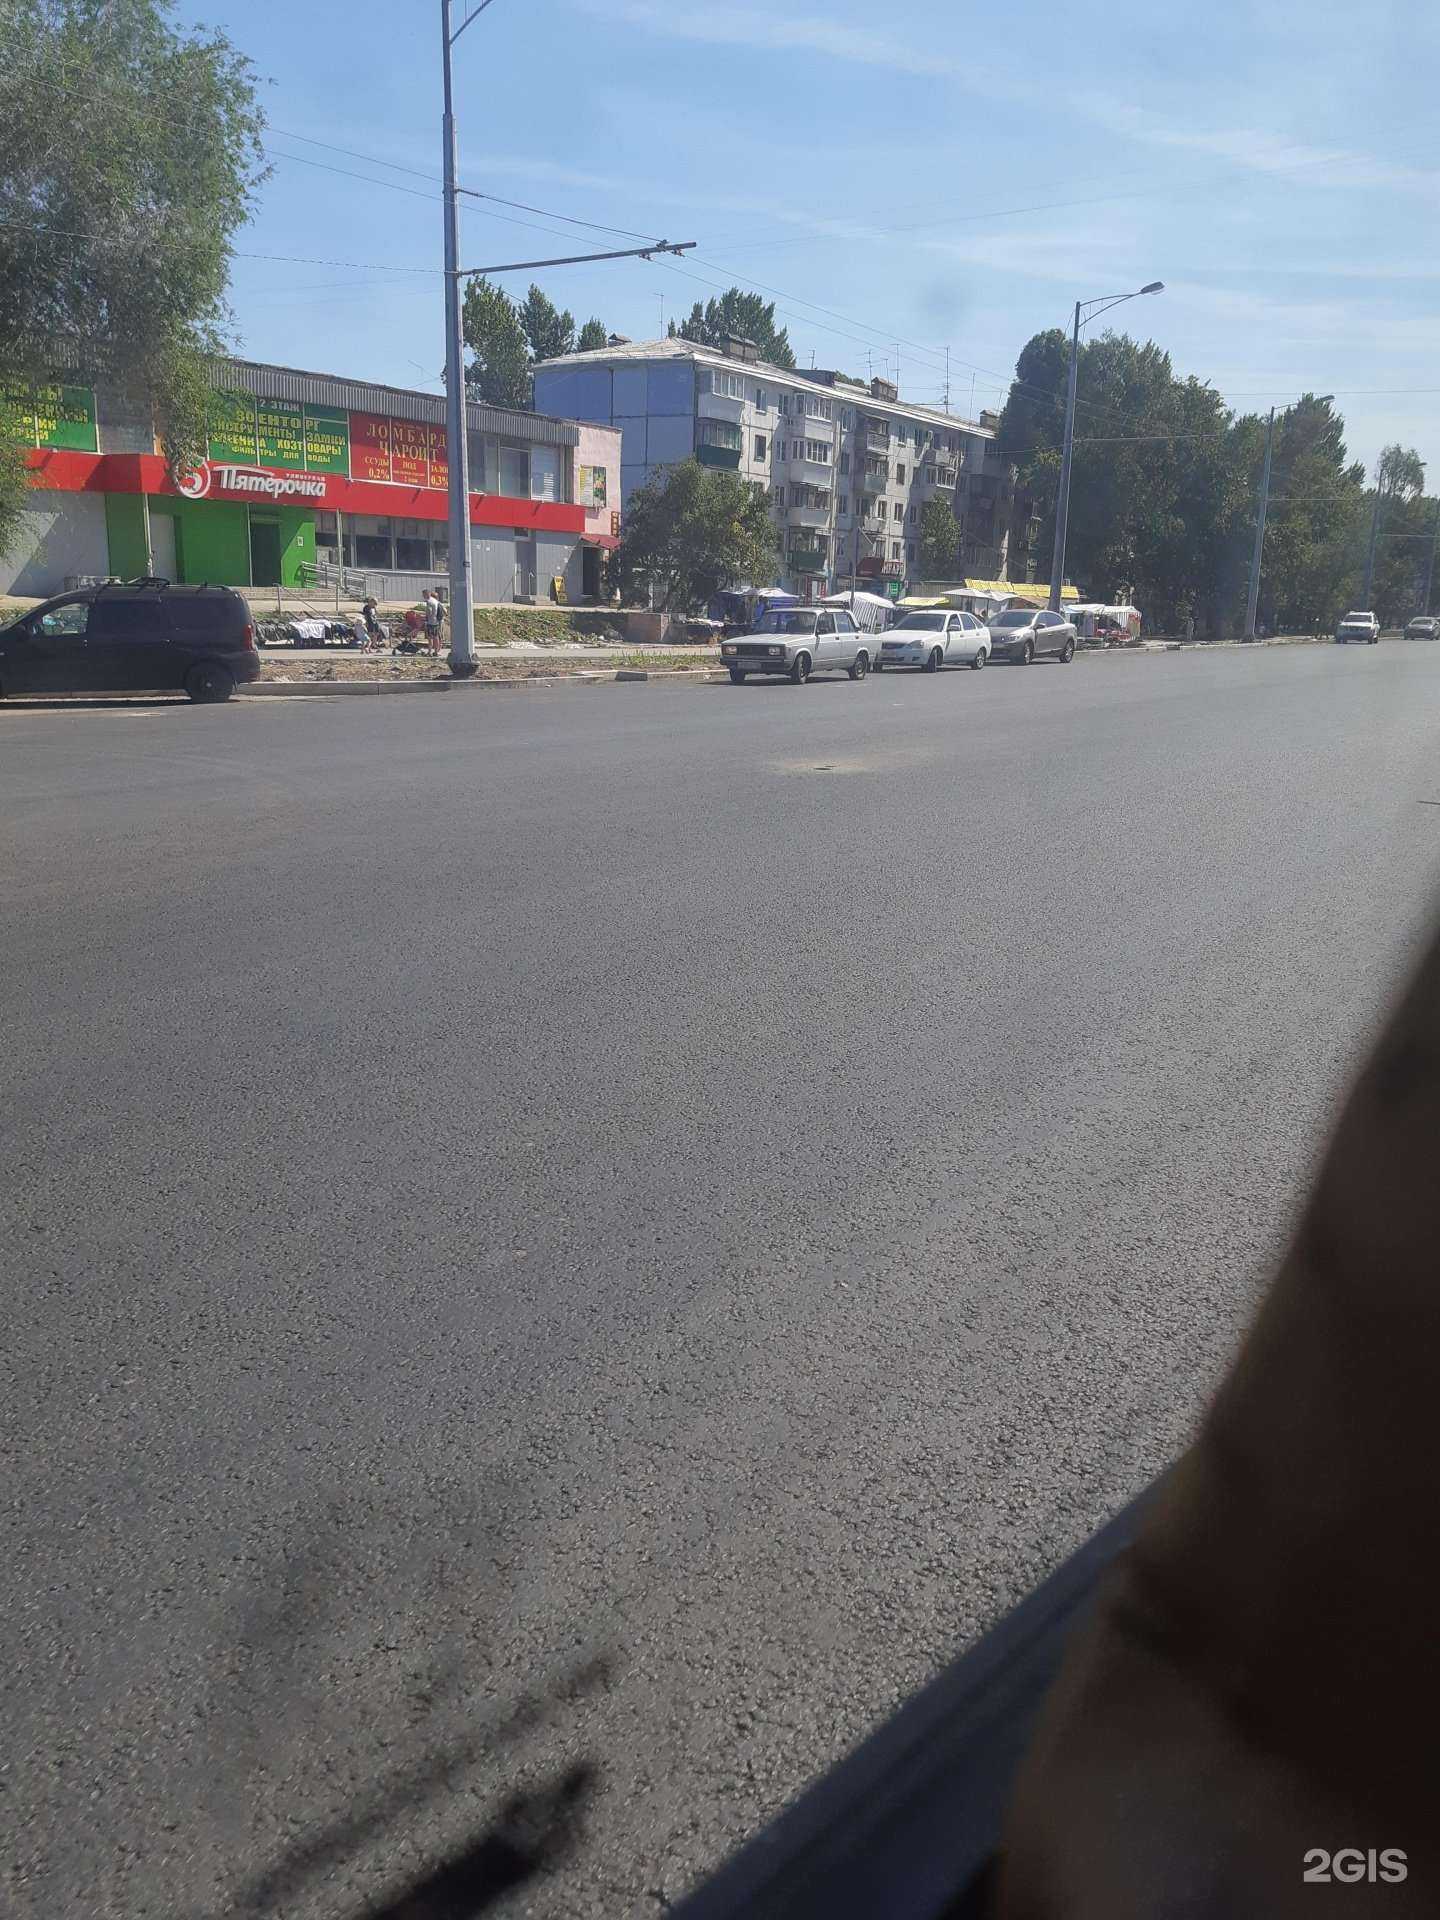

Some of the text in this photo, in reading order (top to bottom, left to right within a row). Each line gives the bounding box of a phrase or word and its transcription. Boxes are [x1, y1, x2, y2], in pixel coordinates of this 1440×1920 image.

[260, 399, 300, 412] 2 ЭТАЖ
[366, 423, 447, 449] ЛОМБАРД
[379, 440, 439, 463] ЧАРОИТ
